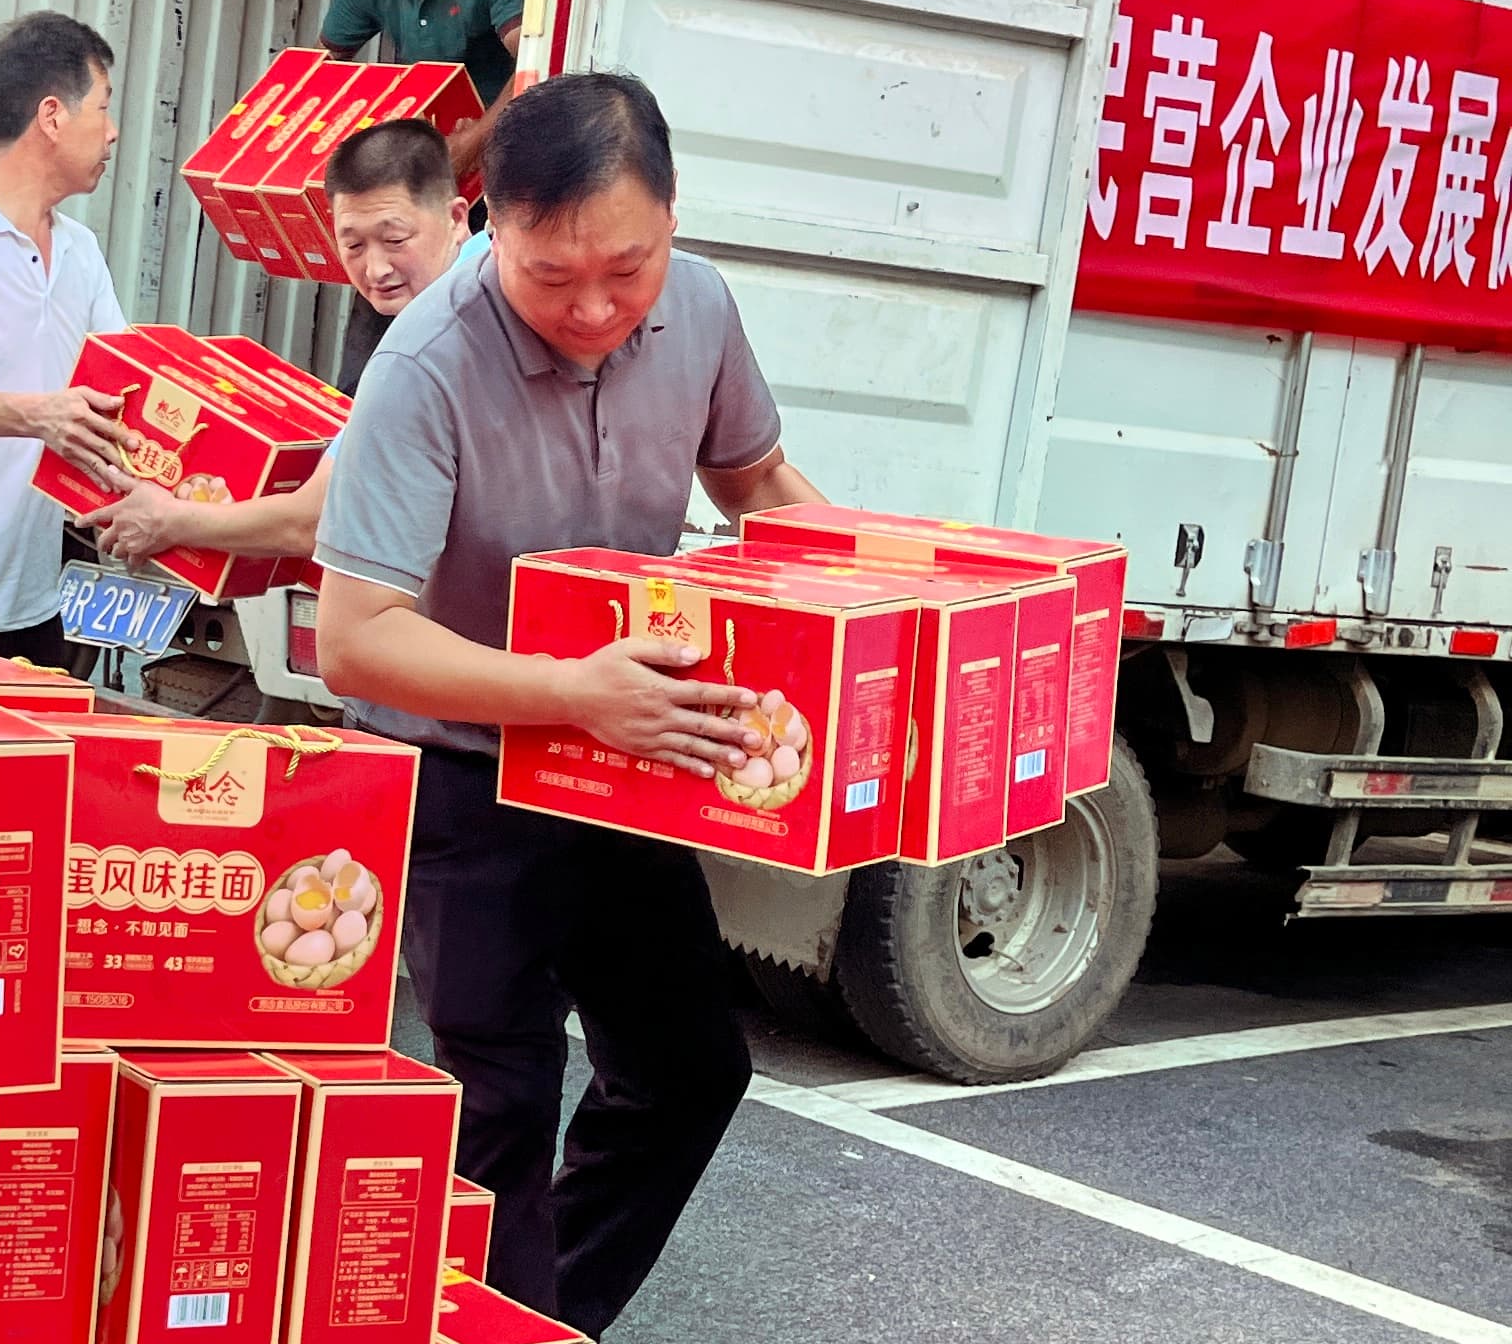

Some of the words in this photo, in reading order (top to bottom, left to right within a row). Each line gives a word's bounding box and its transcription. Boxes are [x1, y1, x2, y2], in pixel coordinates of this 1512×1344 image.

[1089, 13, 1512, 290] 营企业发展
[154, 399, 186, 428] 想念
[647, 610, 696, 642] 想念
[182, 769, 246, 807] 想念
[102, 954, 123, 970] 33
[163, 956, 184, 972] 43
